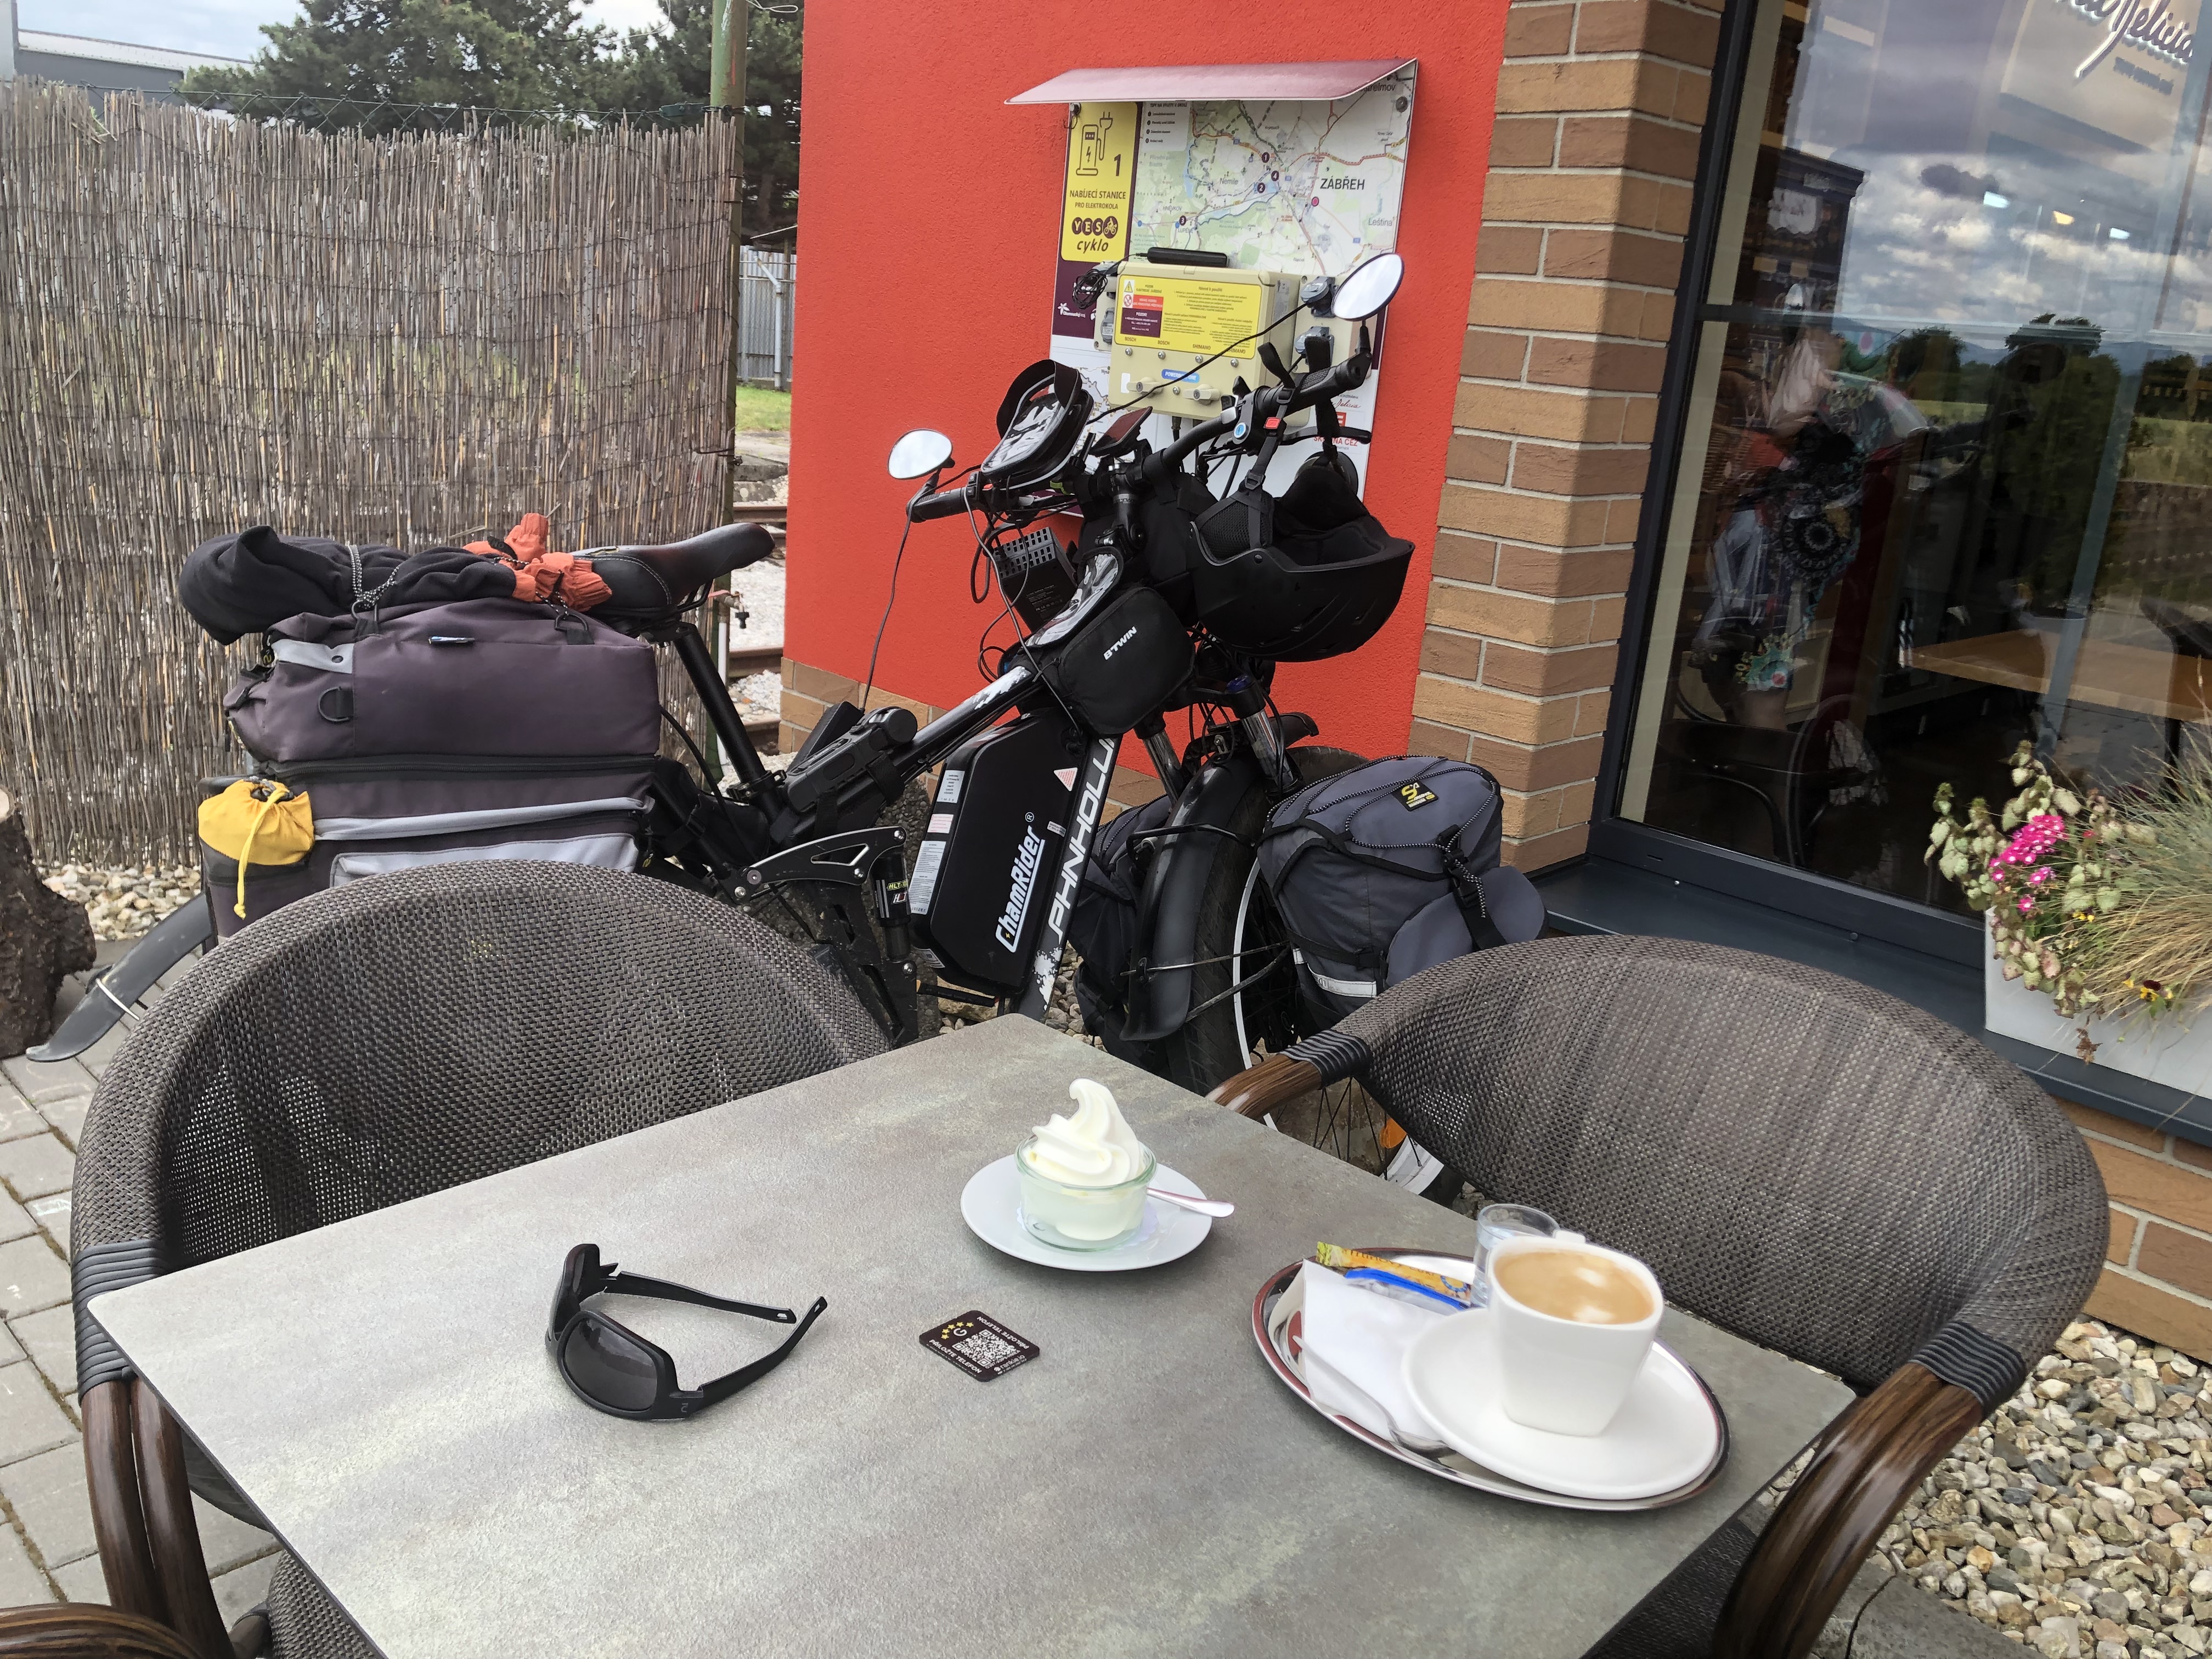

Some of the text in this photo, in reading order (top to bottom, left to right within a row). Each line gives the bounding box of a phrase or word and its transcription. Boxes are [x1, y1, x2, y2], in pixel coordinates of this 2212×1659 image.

[1114, 154, 1121, 176] 1
[1320, 176, 1365, 190] ZÁBŘEH
[1070, 189, 1097, 198] NABÍJECÍ
[1099, 191, 1126, 199] STANICE
[1074, 219, 1102, 234] YES
[1368, 218, 1393, 227] Leština
[1077, 238, 1109, 253] cyklo
[996, 825, 1045, 952] ChamRider
[953, 1328, 967, 1336] G
[977, 1316, 1002, 1335] TELEFON
[955, 1355, 982, 1374] TELEFON
